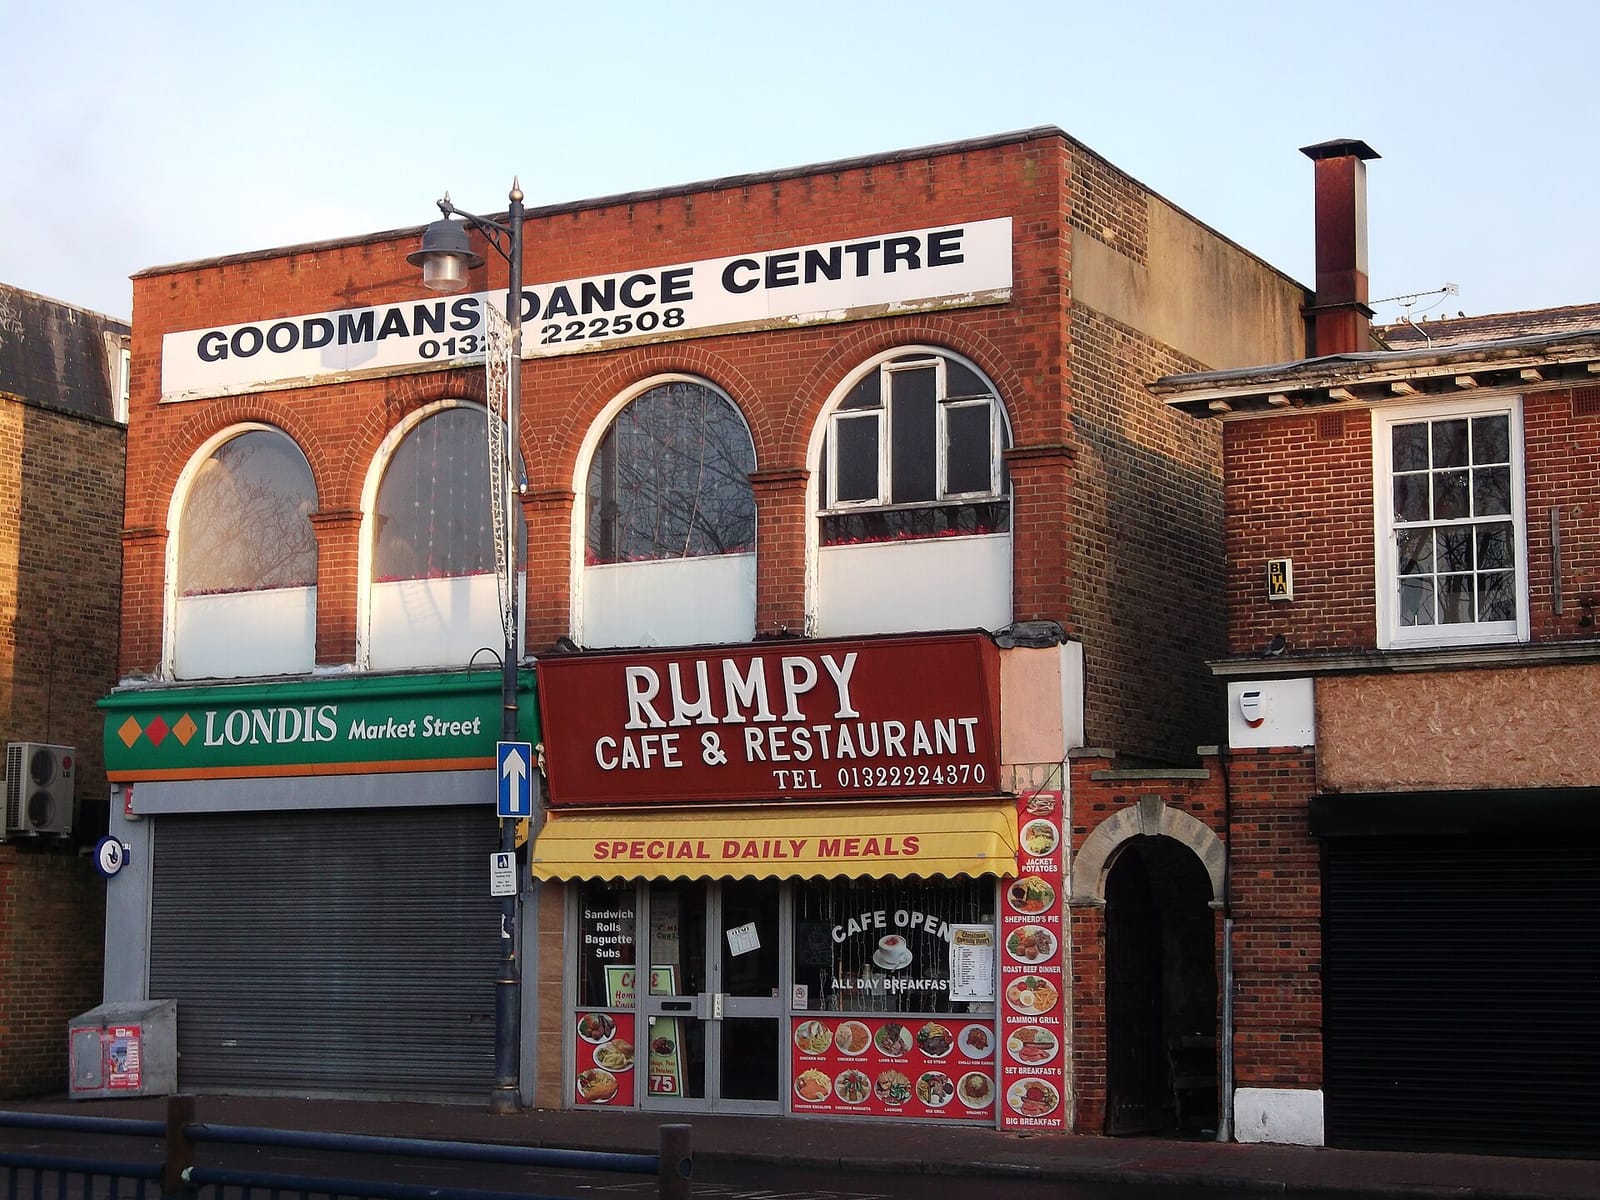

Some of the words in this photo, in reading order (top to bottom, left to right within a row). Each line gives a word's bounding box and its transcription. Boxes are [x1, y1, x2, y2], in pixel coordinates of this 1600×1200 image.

[197, 297, 482, 362] GOODMANS
[506, 267, 693, 323] DANCE
[721, 228, 965, 294] CENTRE
[418, 334, 522, 359] 013
[541, 307, 685, 345] 222508
[624, 652, 860, 731] RUMPY
[203, 705, 339, 746] LONDIS
[348, 718, 417, 741] Market
[422, 714, 481, 738] Street
[595, 732, 683, 771] CAFE
[702, 731, 728, 767] &
[745, 717, 978, 762] RESTAURANT
[773, 769, 822, 791] TEL
[837, 763, 986, 789] 01322224370
[593, 840, 709, 861] SPECIAL
[720, 839, 809, 859] DAILY
[817, 836, 921, 858] MEALS
[1021, 865, 1058, 873] POTATOES
[584, 909, 634, 920] Sandwich
[1004, 915, 1046, 923] SHEPHERD'S
[1048, 915, 1059, 923] PIE
[596, 922, 622, 933] Rolls
[831, 910, 887, 944] CAFE
[894, 909, 950, 943] OPEN
[585, 935, 633, 947] Baguette
[595, 949, 621, 959] Subs
[831, 978, 853, 990] ALL
[857, 978, 878, 990] DAY
[1018, 1067, 1056, 1075] BREAKFAST
[651, 1076, 672, 1092] 75
[1020, 1118, 1061, 1126] BREAKFAST
